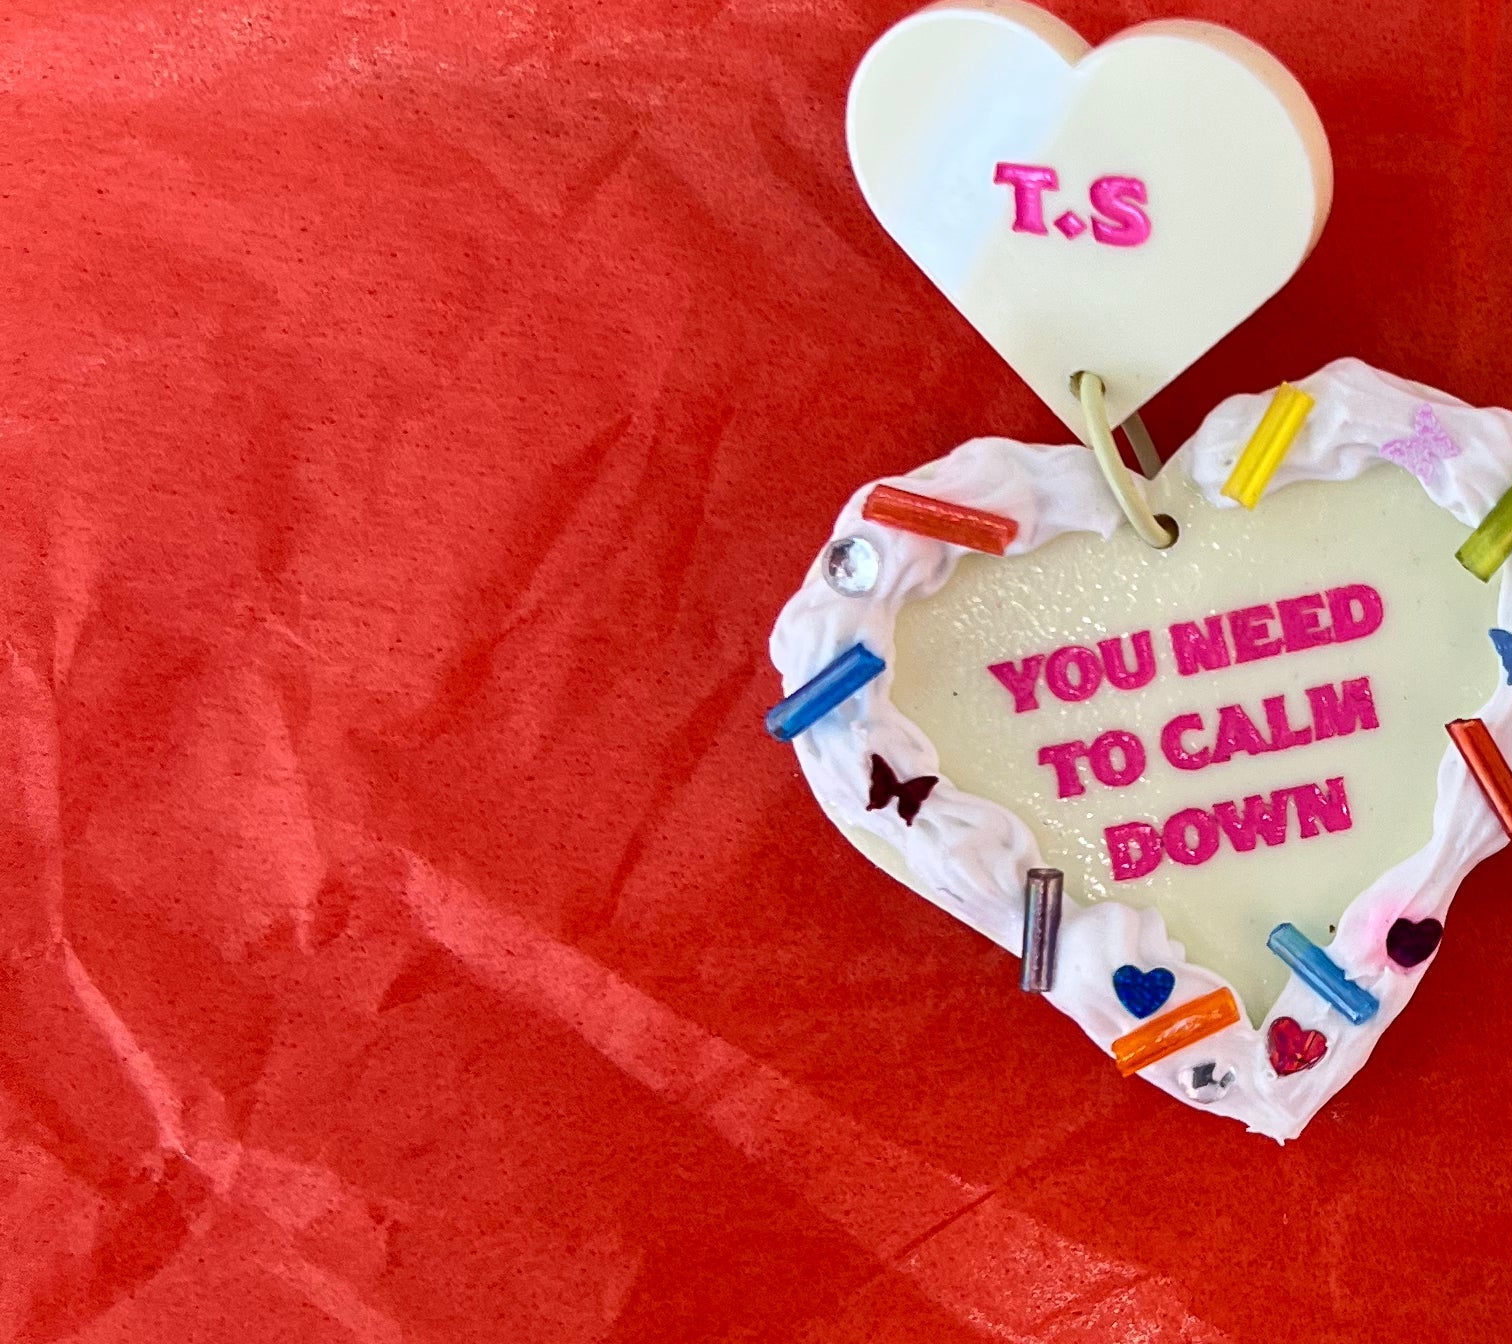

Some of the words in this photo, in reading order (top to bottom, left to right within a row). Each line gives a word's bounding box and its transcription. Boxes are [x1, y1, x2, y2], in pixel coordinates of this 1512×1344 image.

[993, 161, 1153, 249] T.S
[988, 628, 1157, 715] YOU
[1169, 582, 1385, 677] NEED
[1037, 728, 1147, 800] TO
[1160, 674, 1379, 772] CALM
[1104, 776, 1353, 882] DOWN
